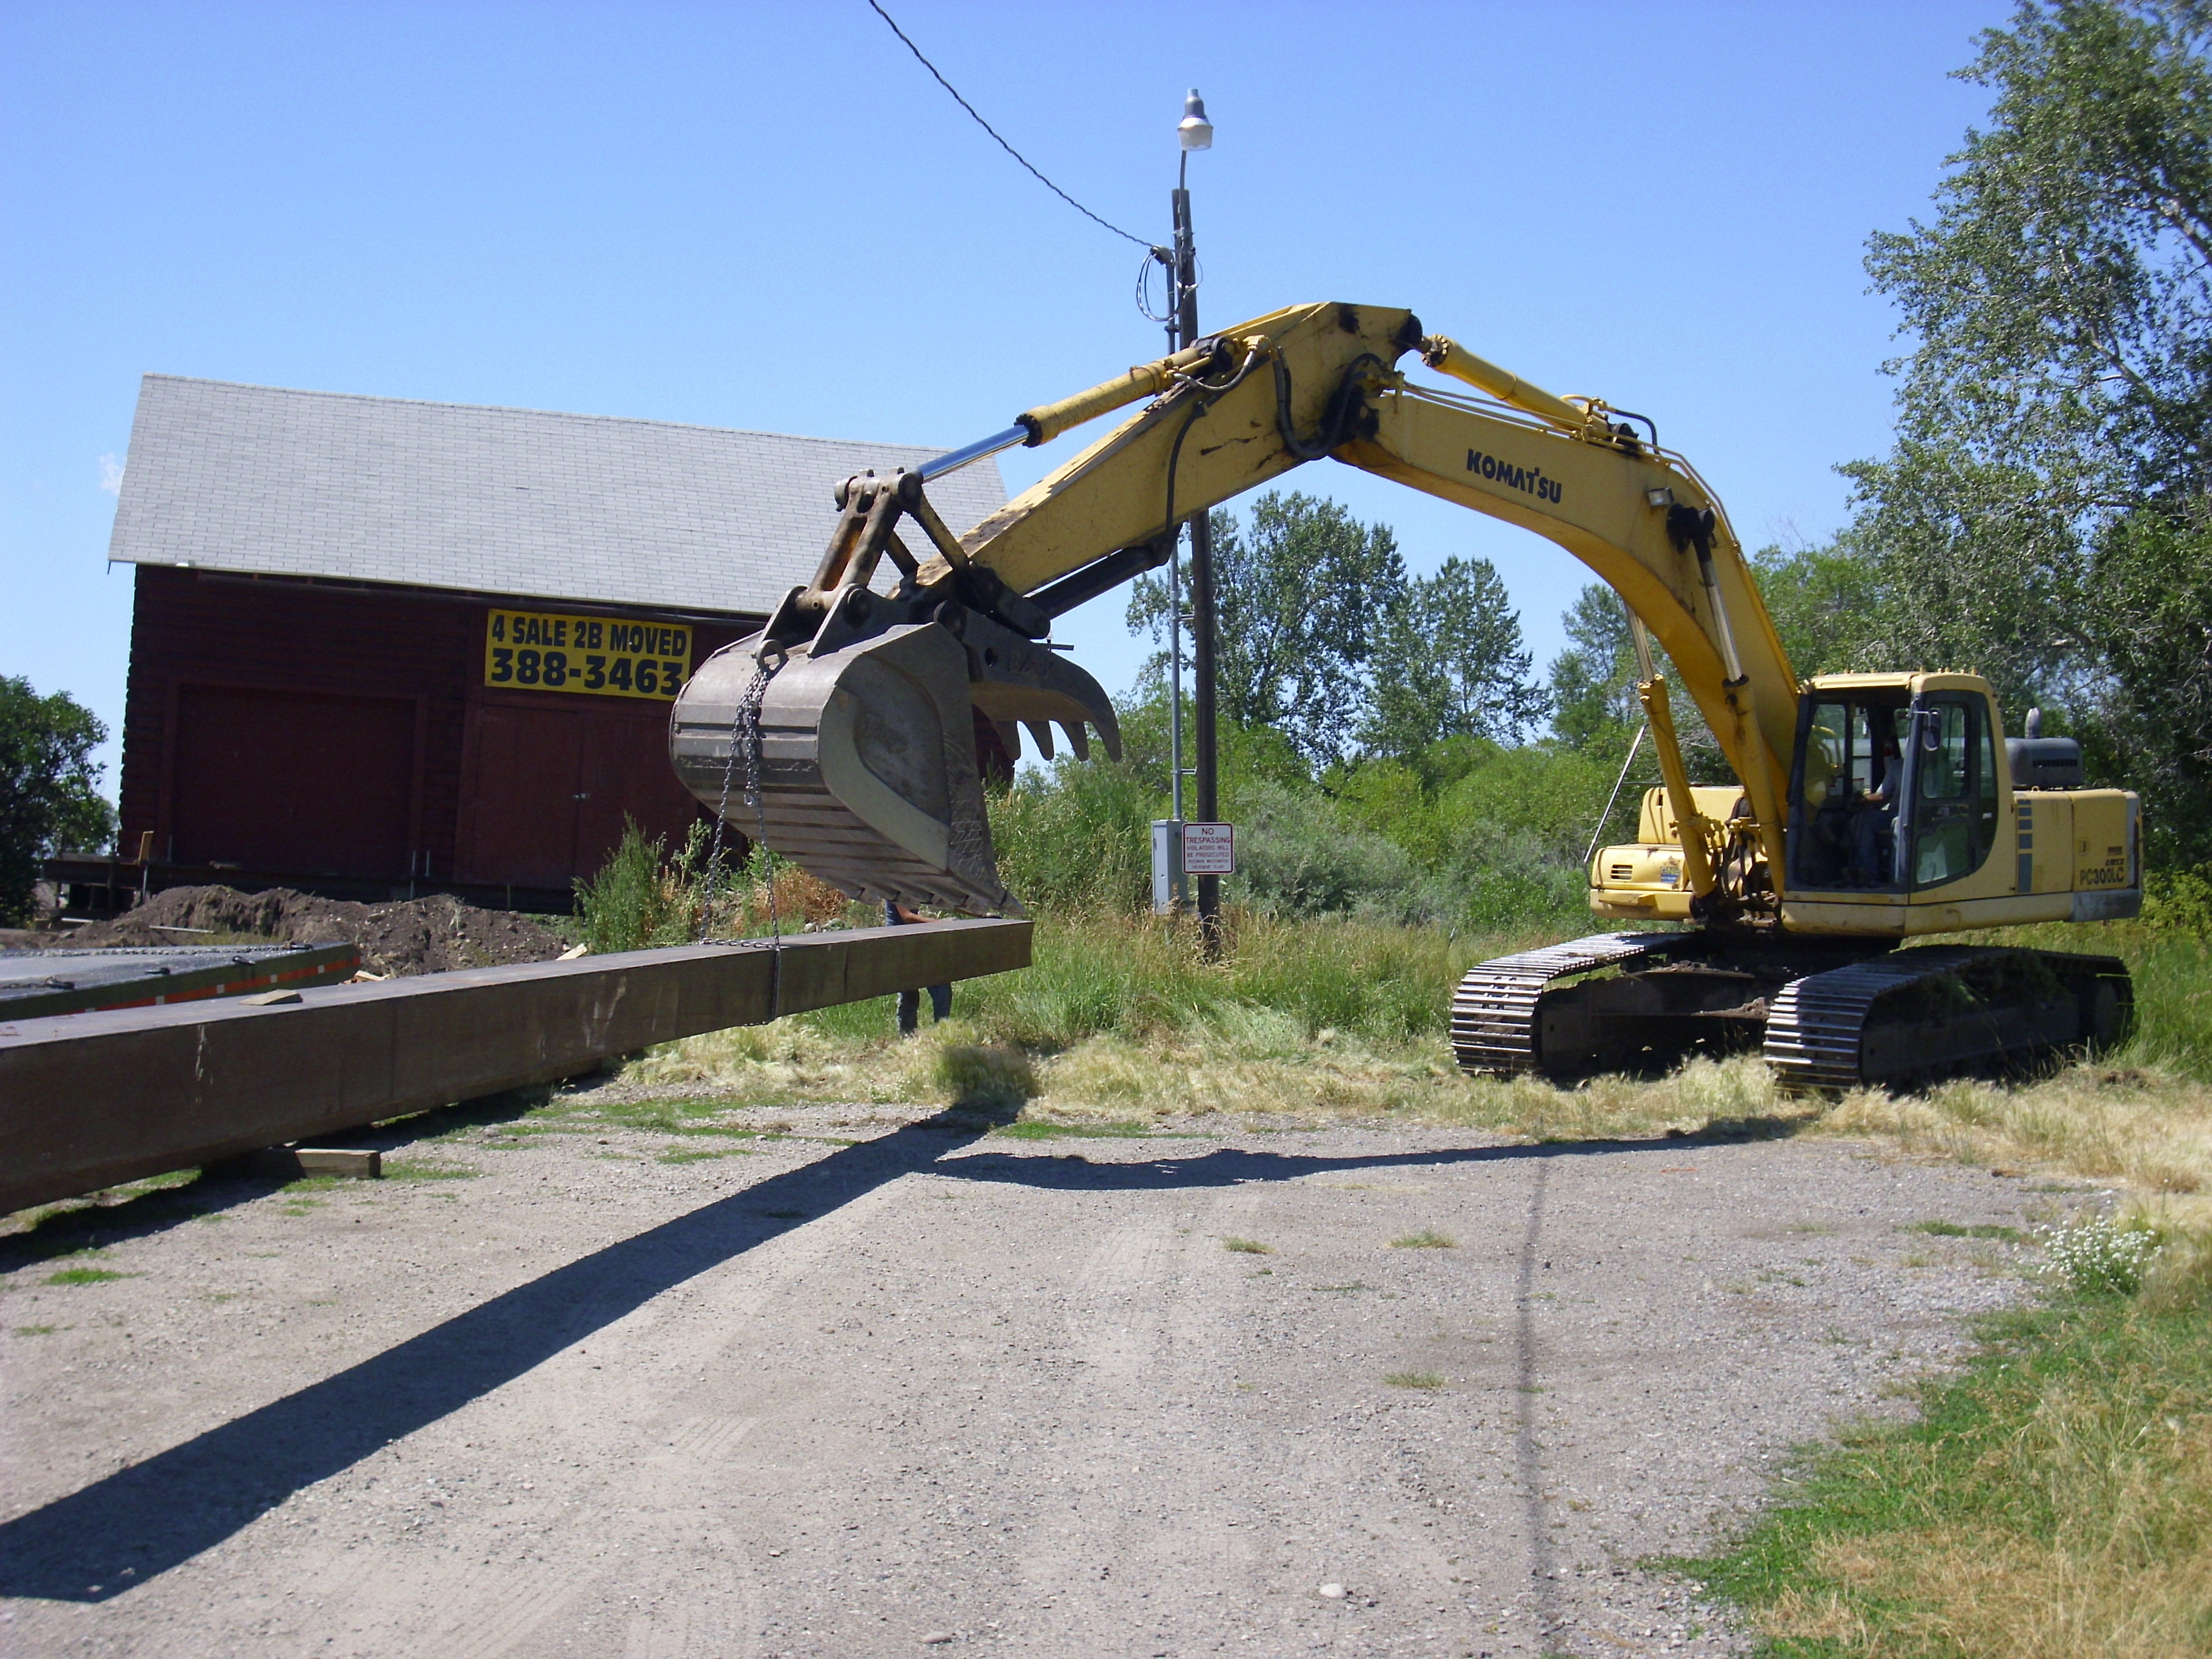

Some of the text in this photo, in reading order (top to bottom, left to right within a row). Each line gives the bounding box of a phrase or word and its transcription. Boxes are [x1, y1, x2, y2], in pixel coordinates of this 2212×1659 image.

[1466, 447, 1563, 504] KOMATSU
[492, 615, 687, 657] 4 SALE 2B MOVED
[491, 647, 683, 696] 388-3463
[2080, 866, 2125, 886] PC300LC
